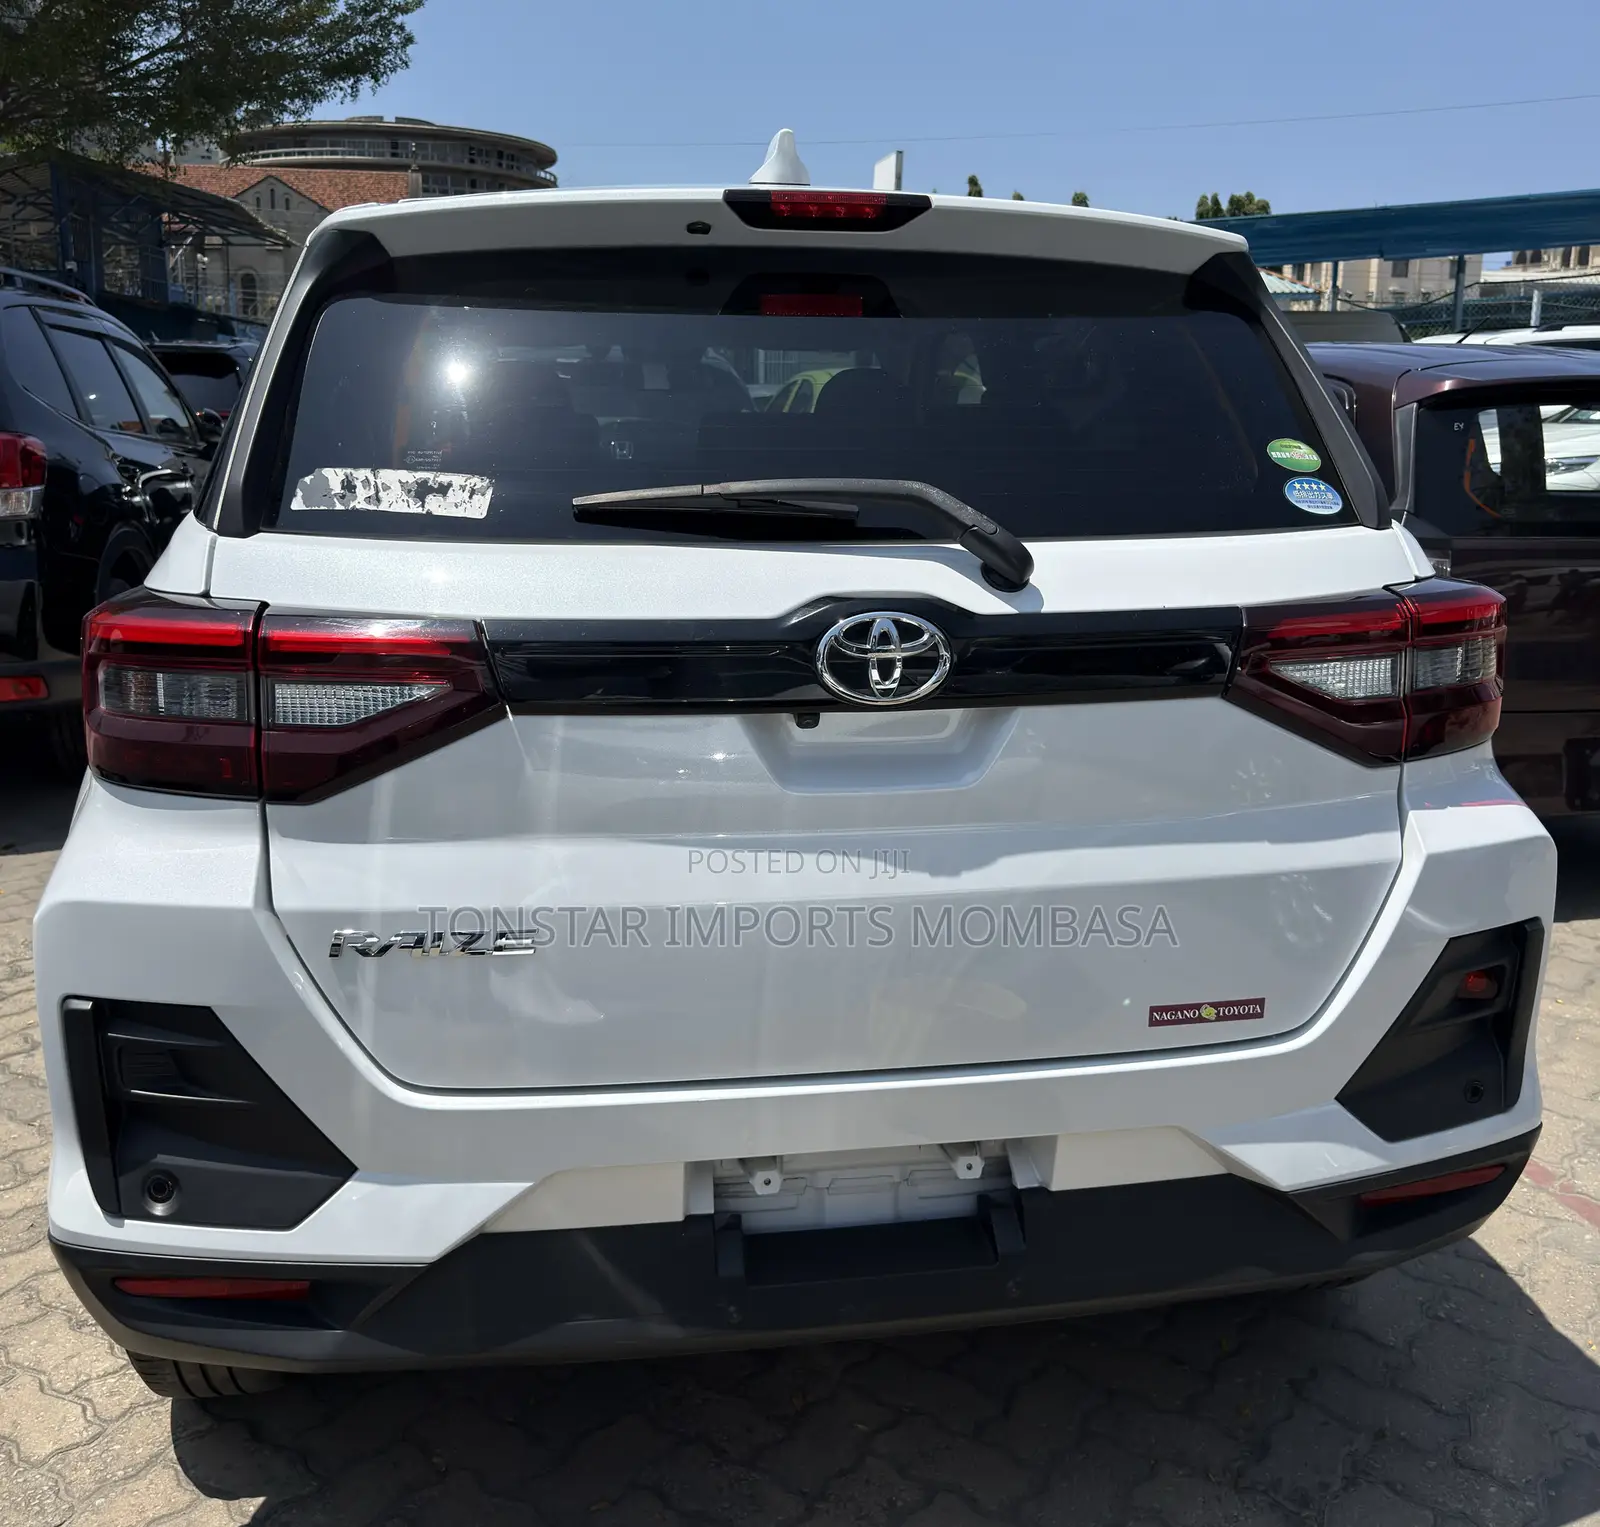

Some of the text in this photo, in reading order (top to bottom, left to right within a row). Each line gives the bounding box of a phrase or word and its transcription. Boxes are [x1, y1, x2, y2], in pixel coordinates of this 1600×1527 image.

[328, 928, 539, 958] RAIZE
[1152, 1004, 1261, 1021] NAGANO TOYOTA
